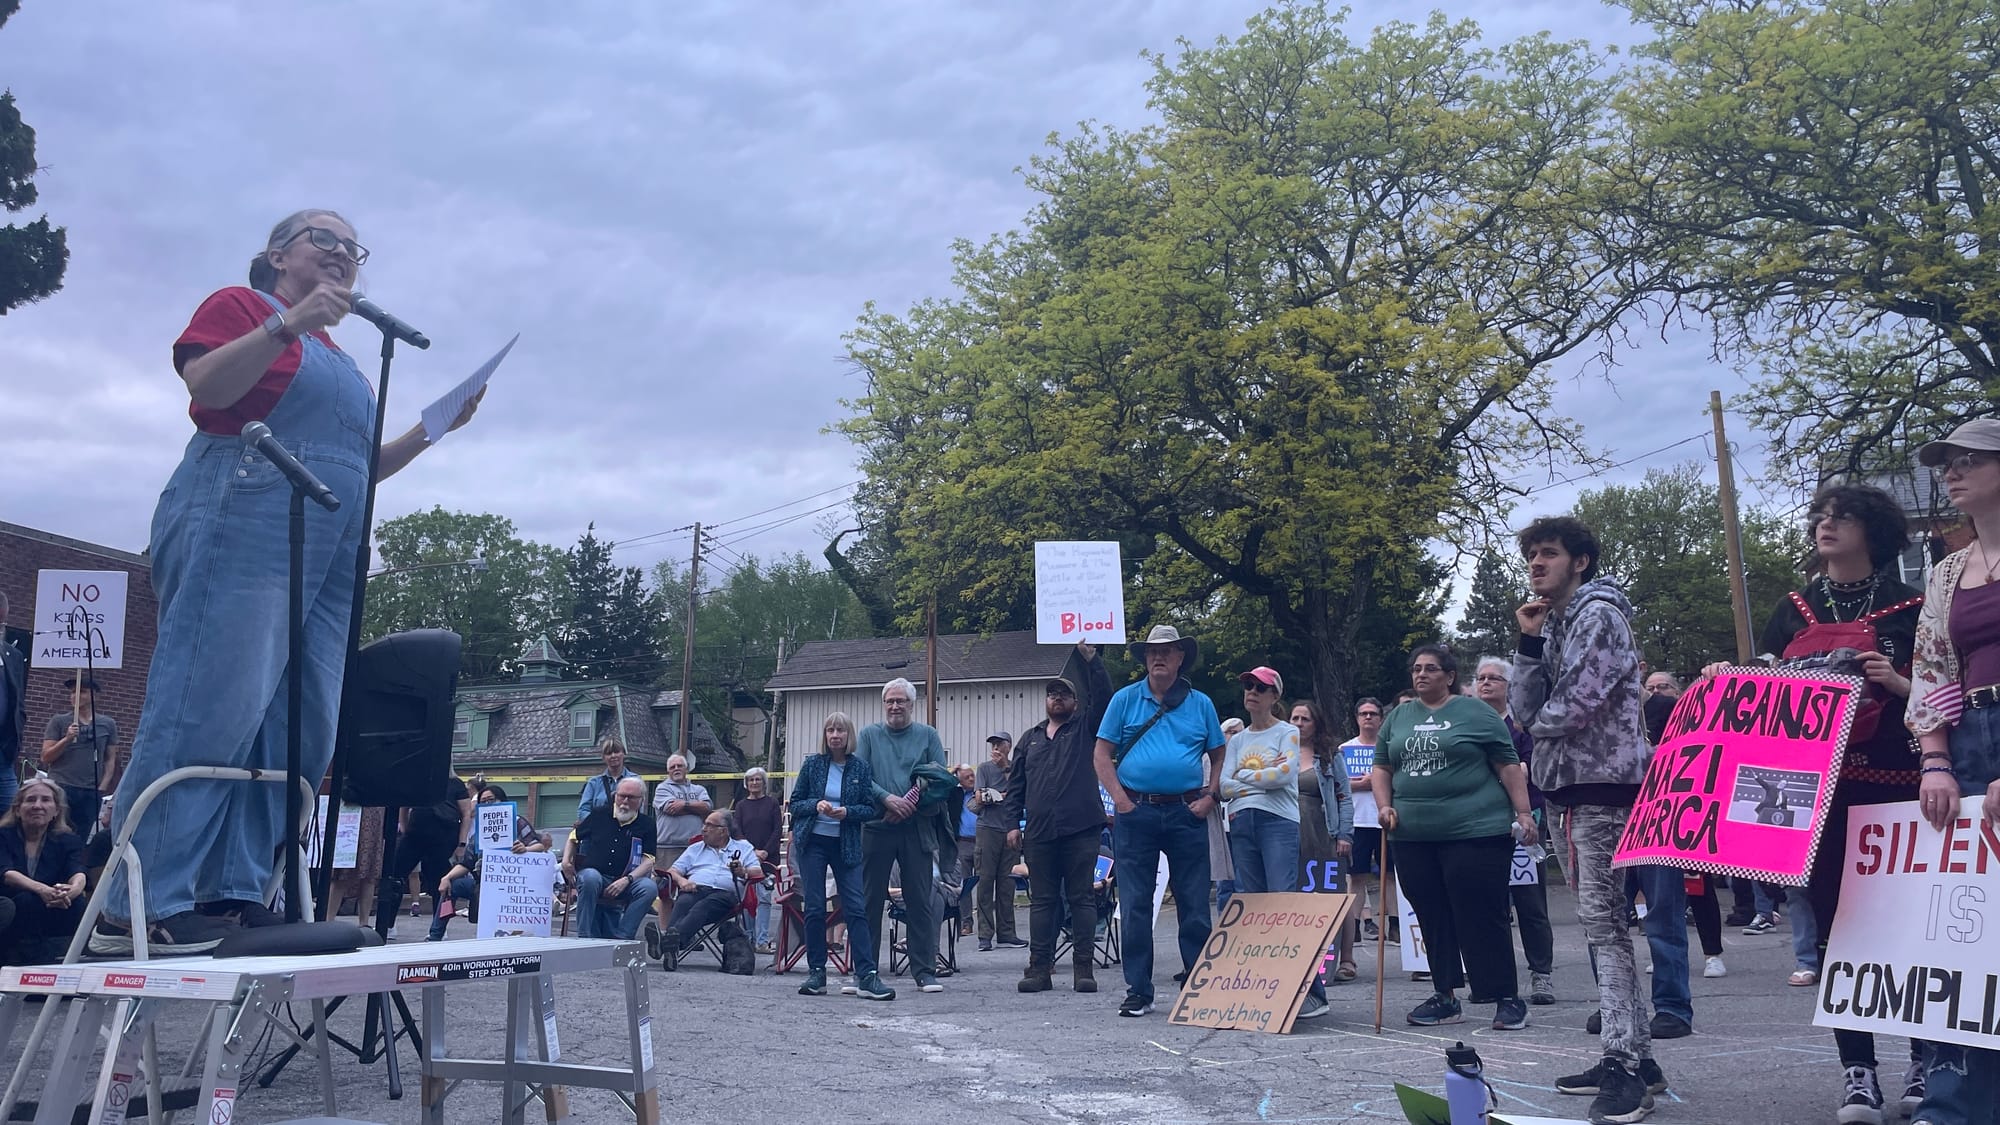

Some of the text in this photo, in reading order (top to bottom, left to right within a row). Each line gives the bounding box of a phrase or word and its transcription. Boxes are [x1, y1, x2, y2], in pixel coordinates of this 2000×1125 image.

[62, 583, 100, 602] NO
[54, 612, 105, 624] KINGS
[1061, 611, 1114, 634] Blood
[41, 647, 112, 659] AMERICA
[1707, 677, 1850, 742] AGAINST
[1404, 736, 1440, 753] CATS
[1353, 749, 1374, 757] STOP
[1639, 744, 1724, 804] NAZI
[483, 811, 508, 820] PEOPLE
[483, 825, 508, 833] PROFIT
[1617, 794, 1721, 855] AMERICA
[486, 854, 550, 867] DEMOCRACY
[485, 864, 522, 875] IS NOT
[484, 874, 528, 885] PERFECT
[509, 896, 551, 906] SILENCE
[500, 905, 550, 915] PERFECTS
[1219, 899, 1329, 934] Dangerous
[1926, 884, 1986, 944] IS
[497, 915, 549, 926] TYRANNY
[1204, 930, 1301, 966] Oligarchs
[398, 966, 439, 981] FRANKLIN
[463, 960, 500, 970] WORKING
[501, 956, 541, 966] PLATFORM
[469, 967, 516, 979] STEP STOOL
[28, 976, 55, 984] DANGER
[114, 977, 144, 986] DANGER
[1190, 961, 1280, 999] Grabbing
[1823, 961, 2000, 1036] COMPLI
[1173, 992, 1272, 1031] Everything
